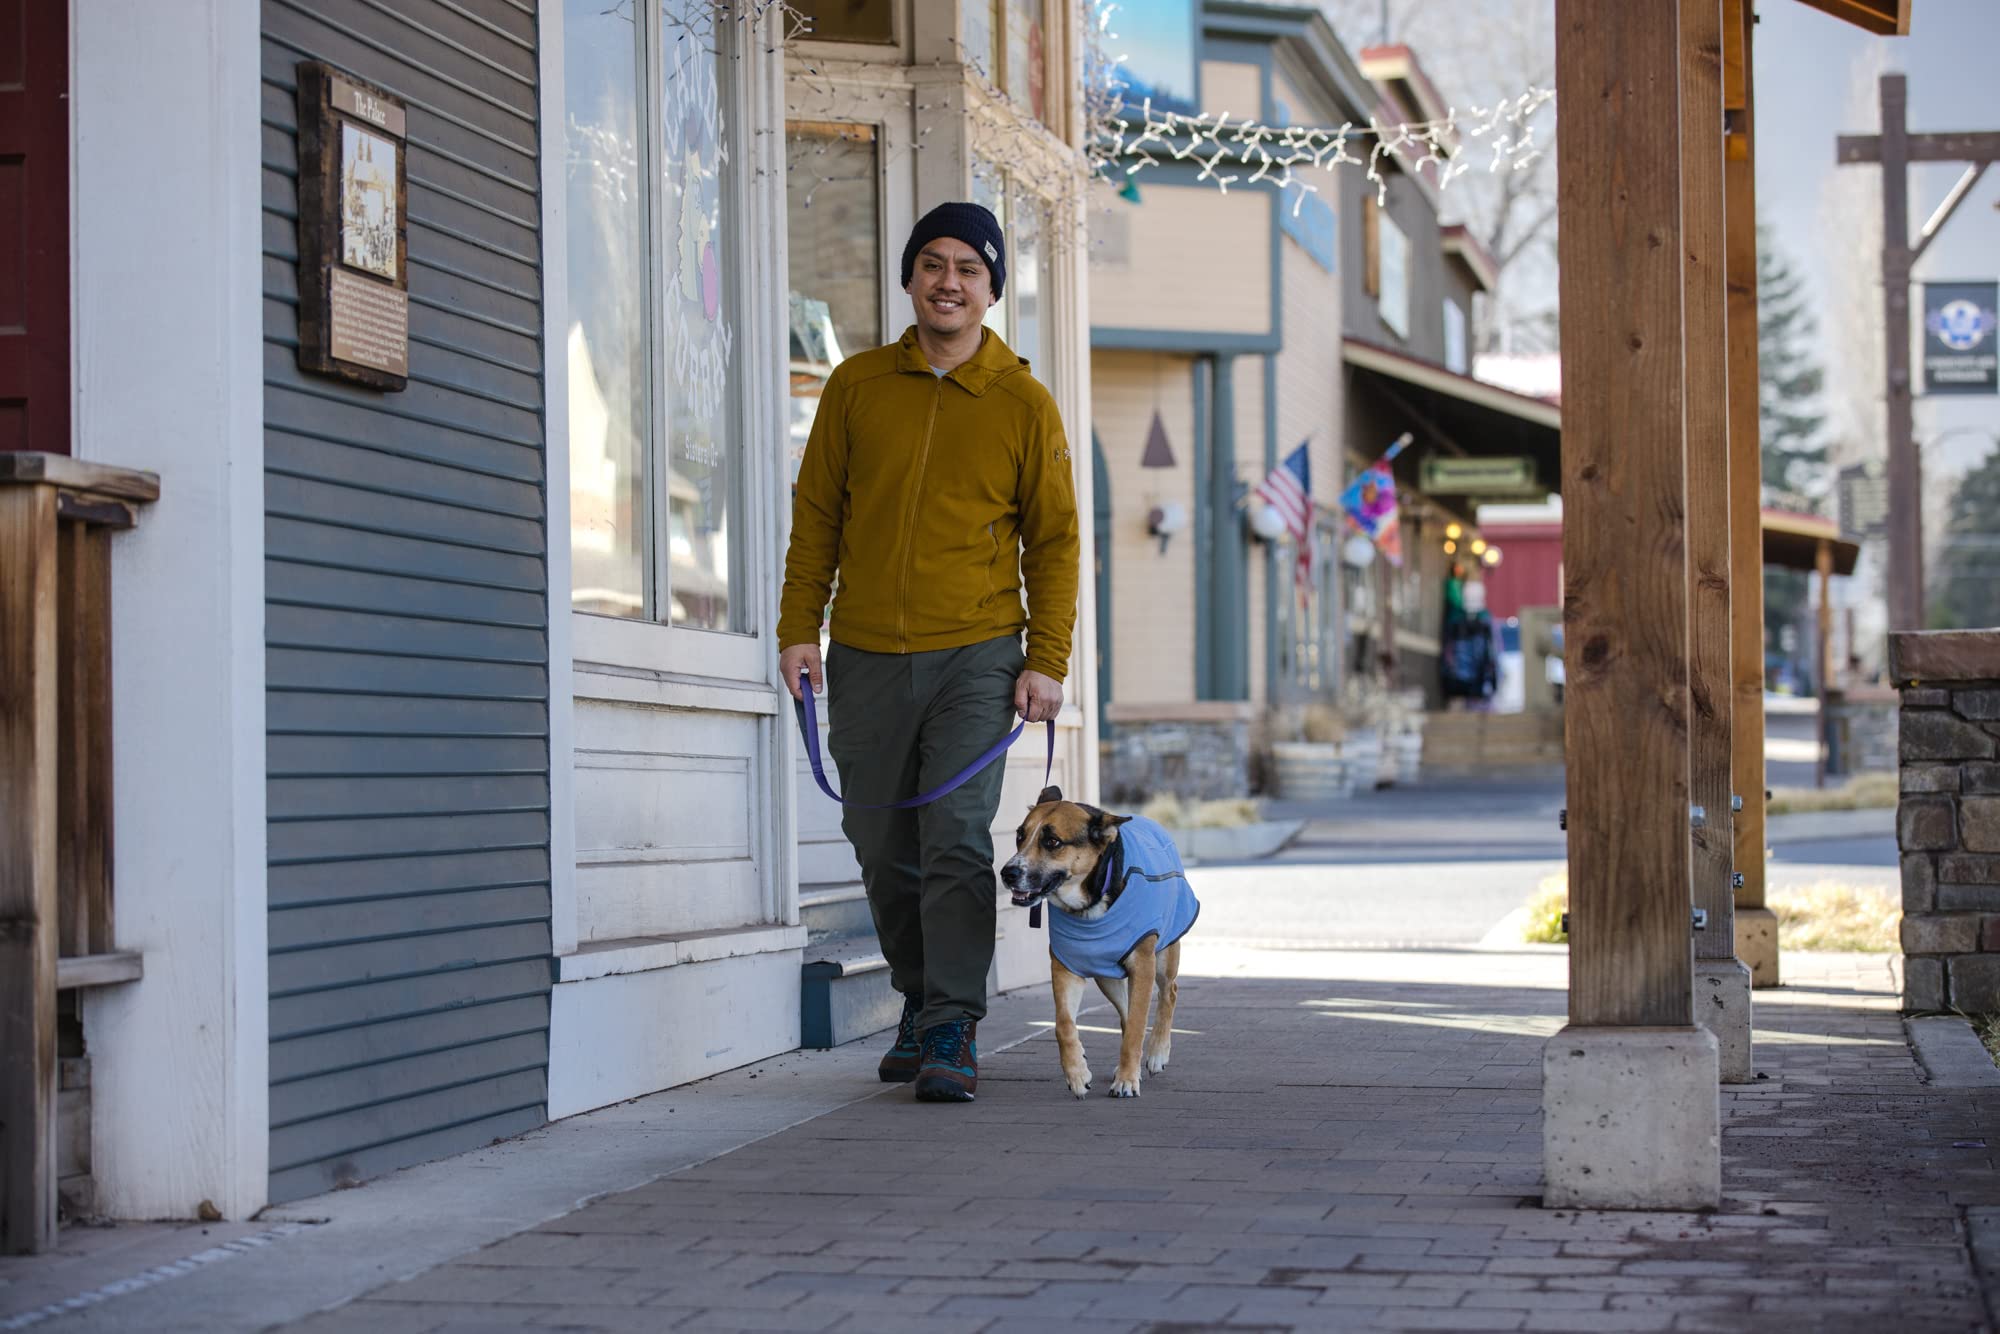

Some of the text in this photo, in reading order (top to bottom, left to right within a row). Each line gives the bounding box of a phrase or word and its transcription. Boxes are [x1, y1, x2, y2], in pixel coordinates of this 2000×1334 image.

[353, 91, 386, 125] The Palace
[664, 31, 729, 175] CANDY
[666, 271, 732, 418] CORRAL
